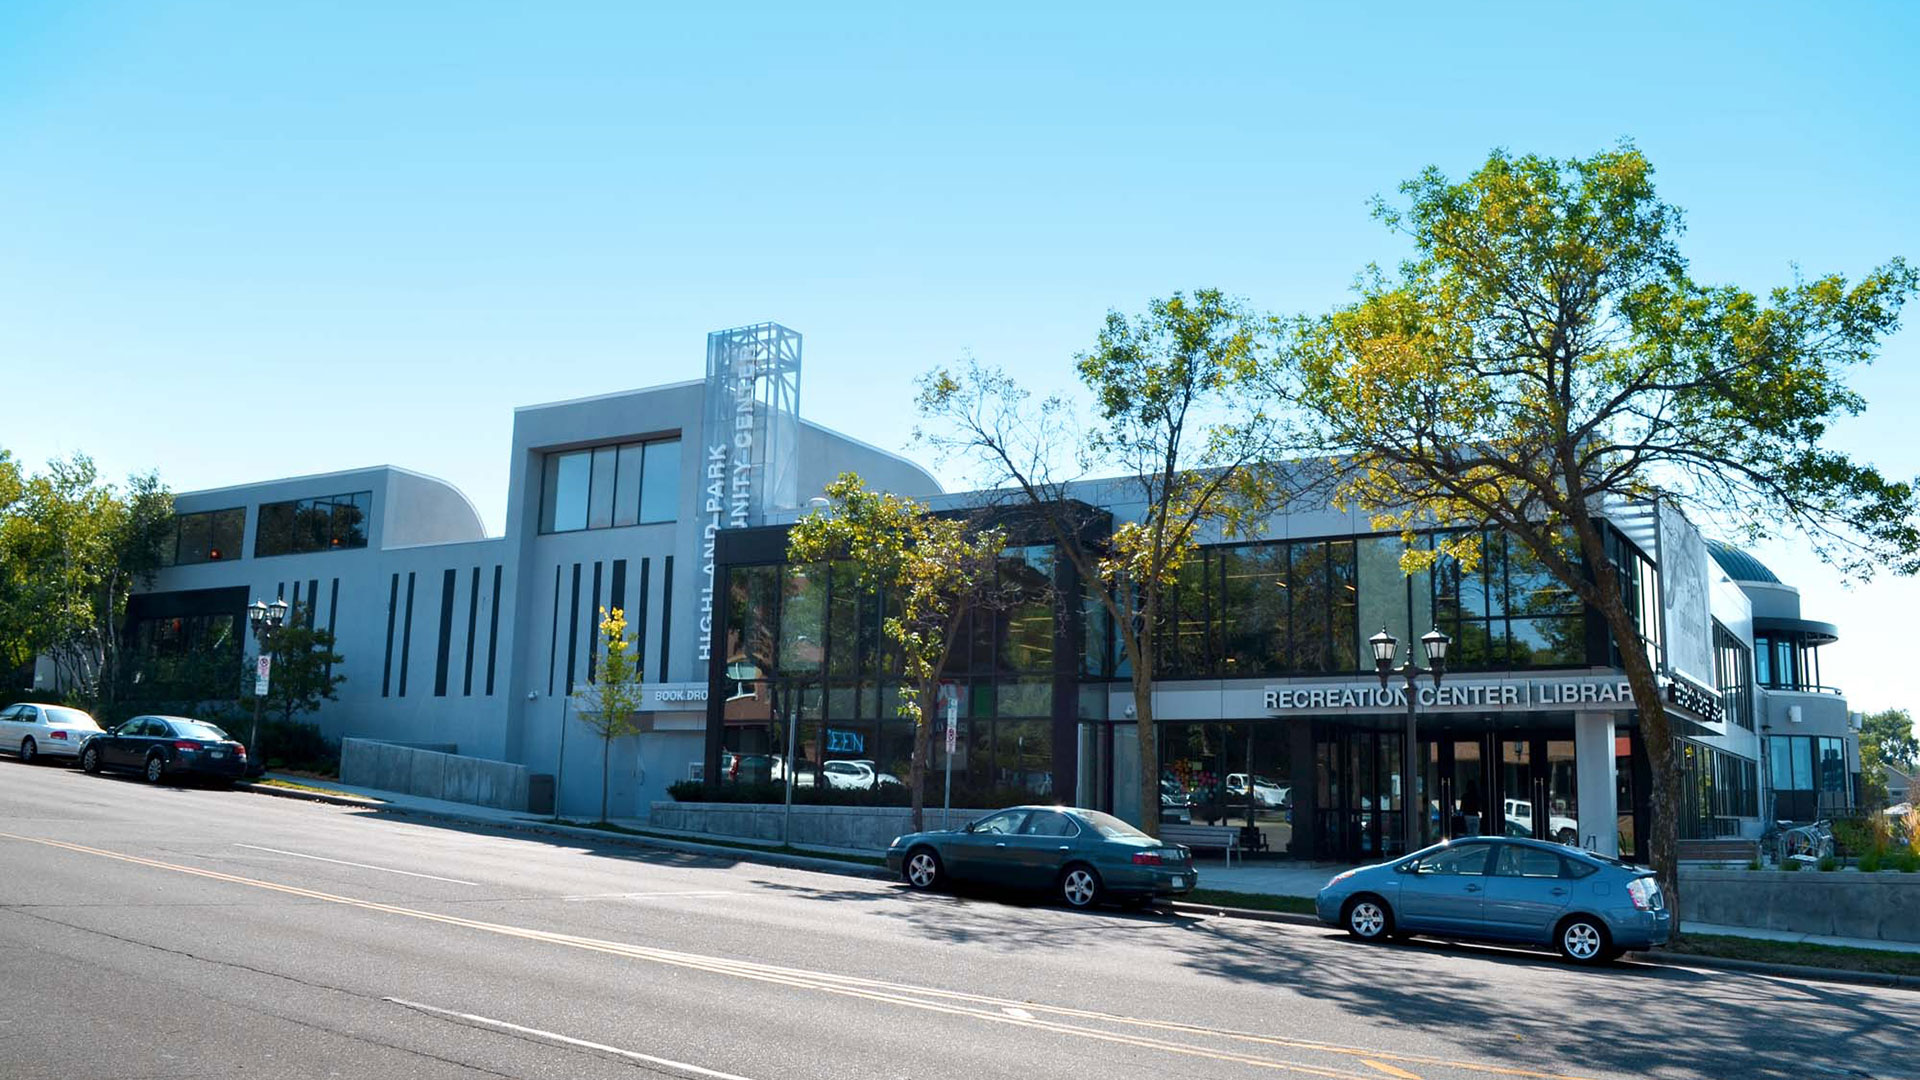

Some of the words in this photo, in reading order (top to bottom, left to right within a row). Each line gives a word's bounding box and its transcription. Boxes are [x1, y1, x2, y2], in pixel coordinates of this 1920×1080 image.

[734, 344, 756, 448] CENTER
[706, 444, 727, 513] PARK
[699, 523, 721, 660] HIGHLAND
[655, 691, 684, 701] BOOK
[686, 690, 709, 701] DRO
[1263, 688, 1408, 708] RECREATION
[1418, 684, 1519, 706] CENTER
[1539, 682, 1635, 704] LIBRAR
[827, 729, 864, 753] EEN
